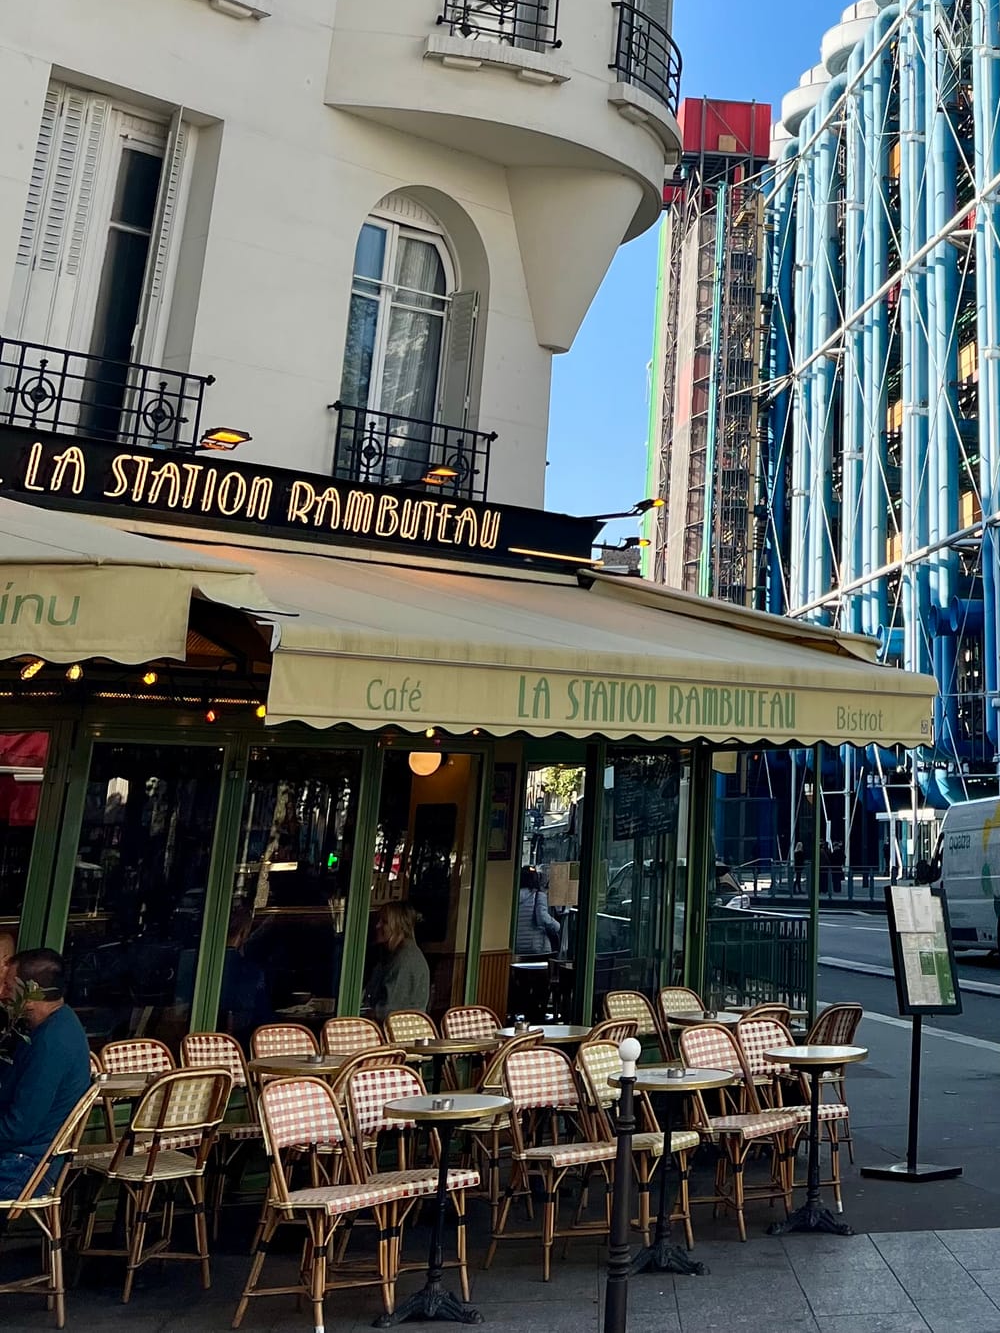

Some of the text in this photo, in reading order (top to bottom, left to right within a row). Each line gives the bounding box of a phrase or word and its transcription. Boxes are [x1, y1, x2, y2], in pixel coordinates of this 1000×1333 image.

[25, 442, 501, 549] LA STATION RAMBUTEAU
[366, 678, 423, 712] Café
[518, 675, 796, 729] LA STATION RAMBUTEAU
[837, 705, 884, 732] Bistrot
